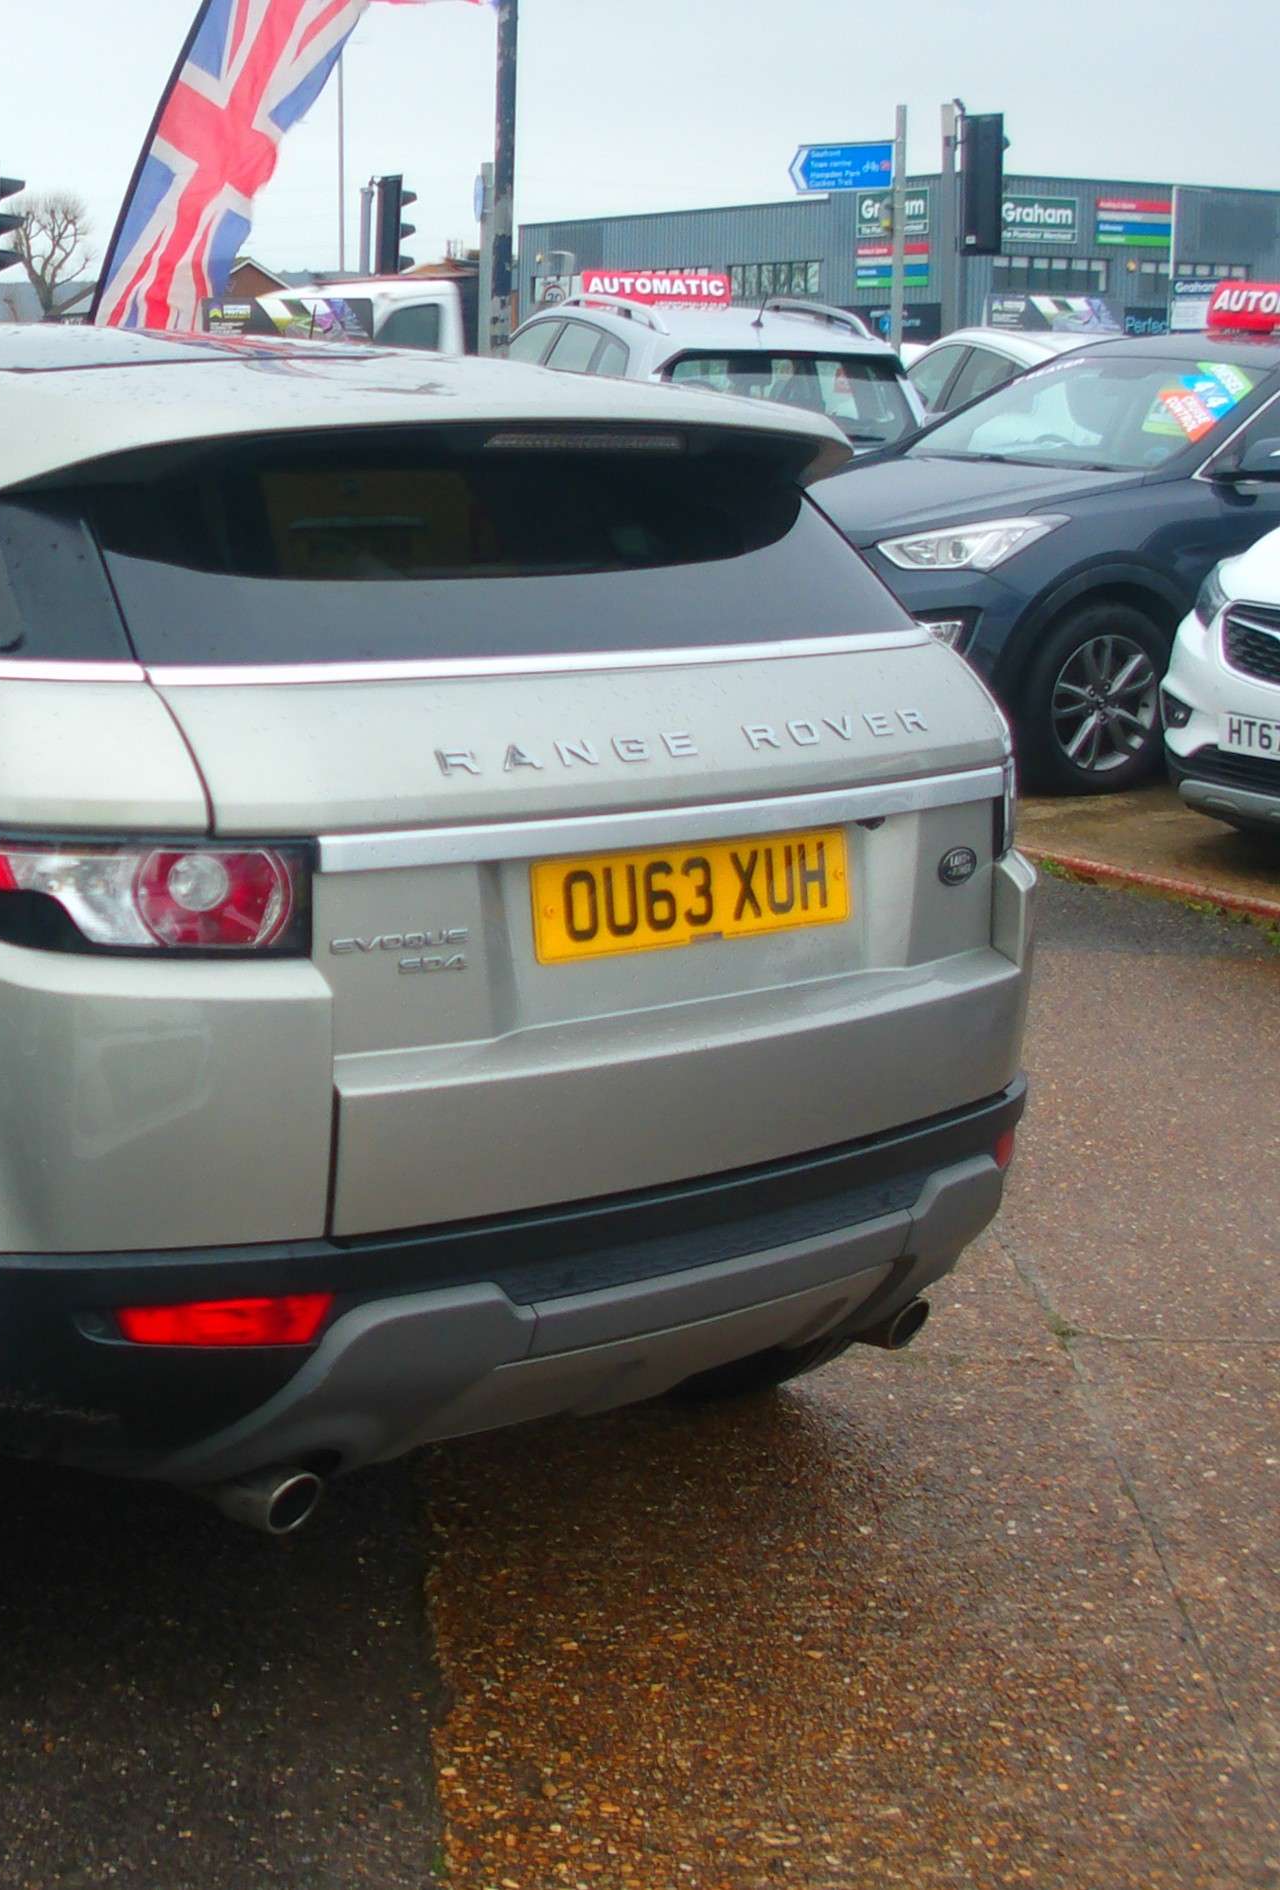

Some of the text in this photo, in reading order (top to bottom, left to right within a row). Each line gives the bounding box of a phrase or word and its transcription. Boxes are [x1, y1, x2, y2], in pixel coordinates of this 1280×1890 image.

[1002, 201, 1073, 224] Graham
[588, 276, 726, 297] AUTOMATIC
[1213, 289, 1280, 315] AUTO
[1125, 316, 1168, 334] Perfec
[434, 708, 928, 776] RANGE ROVER
[563, 841, 828, 943] OU63 XUH
[331, 928, 469, 955] EVOQUE
[399, 953, 467, 974] SD4
